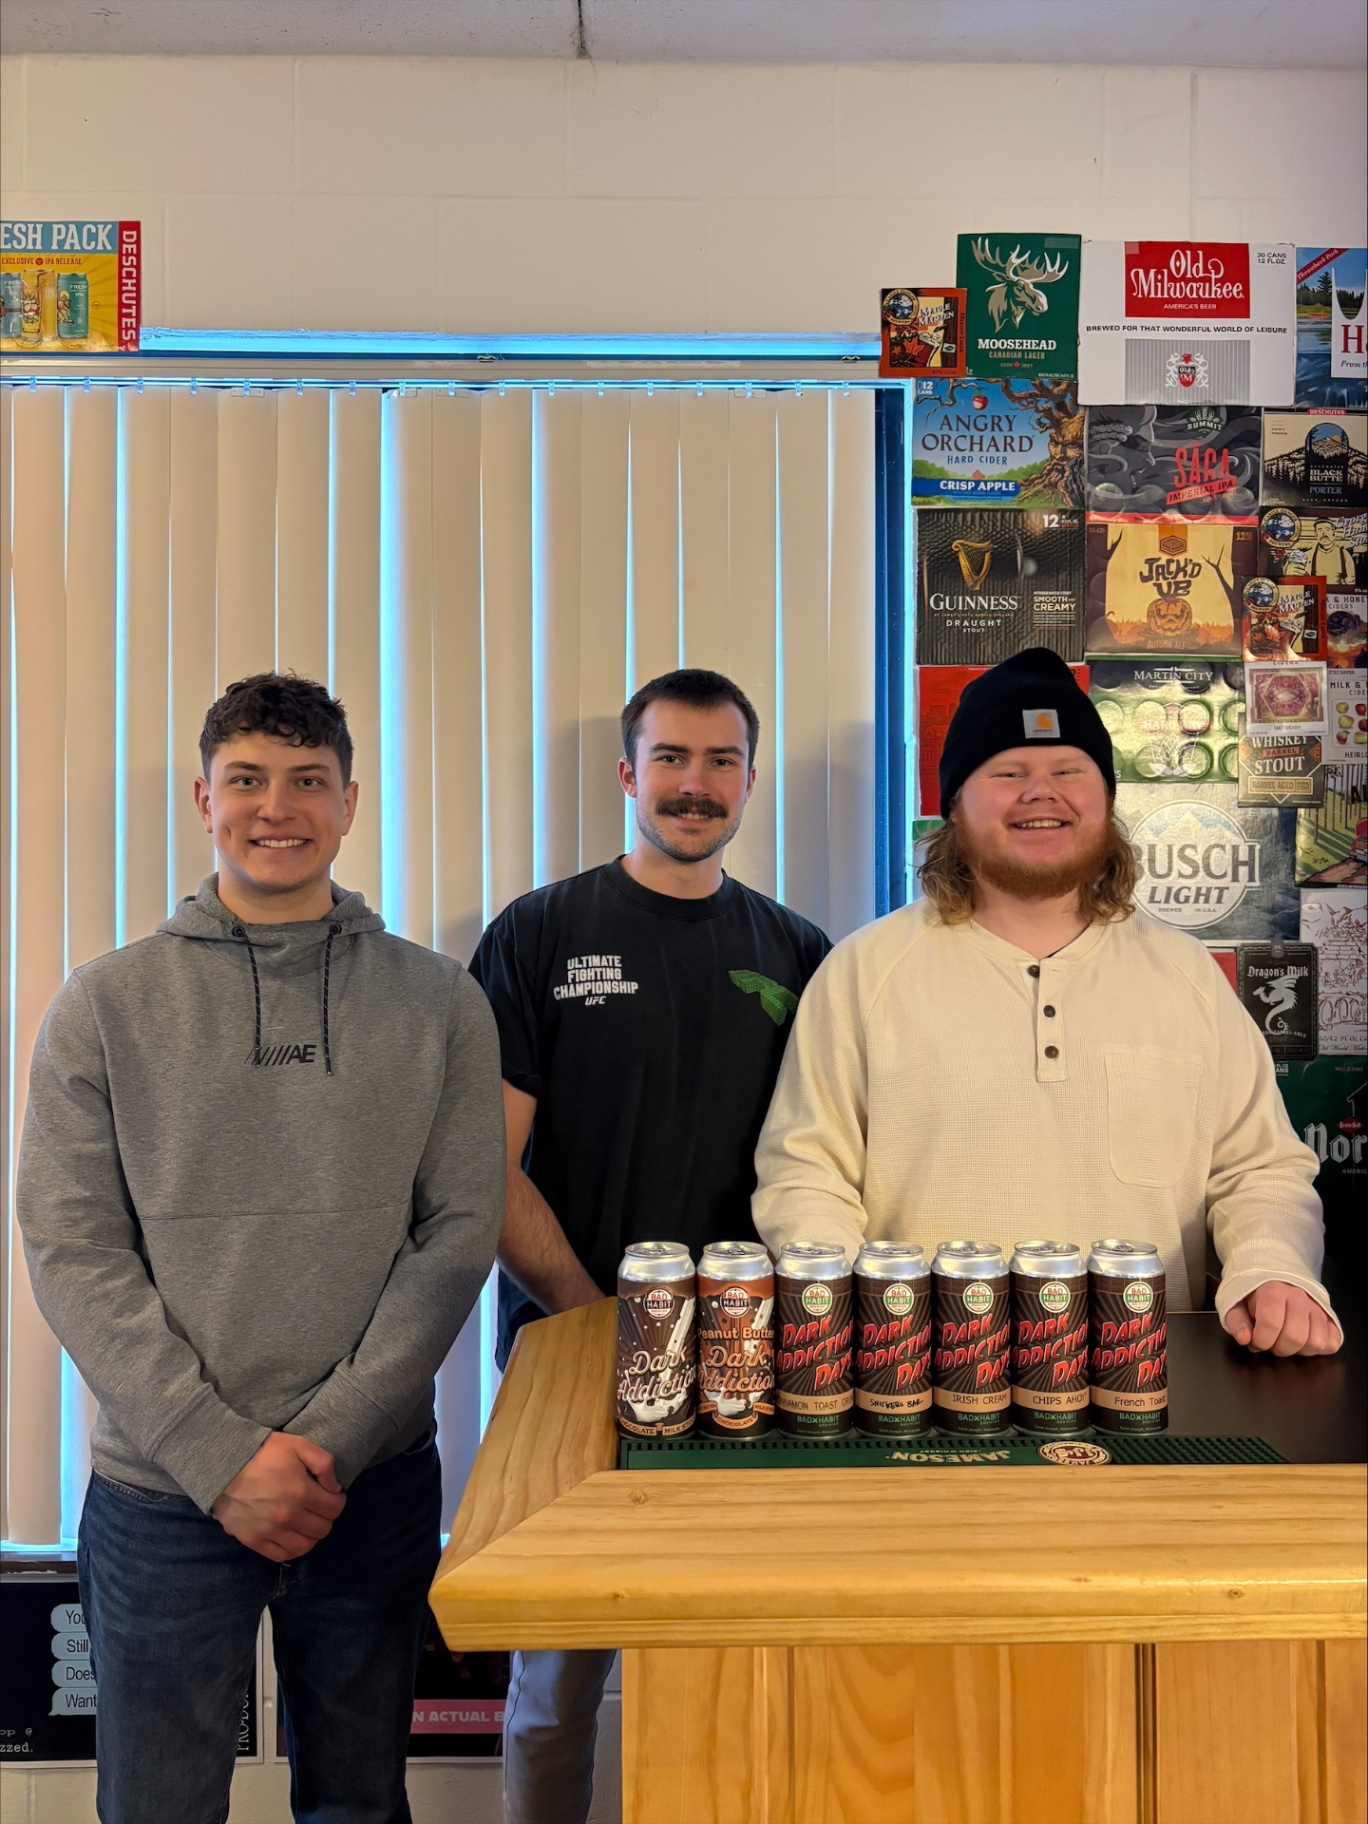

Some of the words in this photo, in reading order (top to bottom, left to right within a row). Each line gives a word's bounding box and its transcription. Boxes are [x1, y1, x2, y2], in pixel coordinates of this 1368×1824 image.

[51, 224, 113, 250] PACK
[1169, 250, 1224, 279] Old
[122, 230, 137, 341] DESCHUTES
[1130, 268, 1245, 299] Milwaukee
[1163, 325, 1212, 333] WONDERFUL
[1256, 326, 1288, 334] LEISURE
[977, 338, 1057, 351] MOOSEHEAD
[989, 351, 1022, 359] CANADIAN
[1024, 352, 1045, 360] LAGER
[1340, 360, 1361, 368] From
[921, 381, 934, 390] 12
[938, 414, 1018, 432] ANGRY
[1187, 421, 1223, 431] SUMMIT
[921, 433, 1034, 453] ORCHARD
[947, 455, 974, 465] HARD
[979, 455, 1008, 466] CIDER
[939, 480, 976, 491] CRISP
[977, 481, 1016, 491] APPLE
[1169, 485, 1215, 502] IMPERIAL
[1218, 480, 1233, 490] IPA
[1309, 486, 1342, 494] PORTER
[1043, 514, 1059, 528] 12
[1139, 557, 1202, 583] JACK'D
[1033, 603, 1077, 611] CREAMY
[946, 619, 1002, 627] DRAUGHT
[1147, 640, 1172, 649] AUTUMN
[1173, 641, 1186, 650] ALE
[1134, 670, 1182, 681] MARTIN
[1185, 671, 1214, 681] CITY
[1330, 681, 1351, 689] MILK
[1251, 735, 1309, 749] WHISKEY
[1266, 748, 1297, 756] BARREL
[1254, 756, 1306, 775] STOUT
[1147, 886, 1230, 905] LIGHT
[566, 954, 622, 971] ULTIMATE
[567, 968, 622, 983] FIGHTING
[1247, 965, 1284, 979] Dragon's
[1286, 965, 1309, 977] Milk
[553, 981, 639, 1001] CHAMPIONSHIP
[585, 996, 607, 1006] UFC
[727, 1291, 745, 1300] BAD
[809, 1289, 826, 1297] BAD
[891, 1289, 908, 1297] BAD
[970, 1288, 987, 1296] BAD
[1047, 1287, 1064, 1295] BAD
[1131, 1287, 1147, 1295] BAD
[651, 1293, 668, 1301] BAD
[806, 1296, 830, 1304] HABIT
[887, 1296, 911, 1304] HABIT
[967, 1295, 991, 1303] HABIT
[1043, 1294, 1067, 1302] HABIT
[1127, 1294, 1151, 1302] HABIT
[646, 1300, 672, 1308] HABIT
[723, 1299, 748, 1307] HABIT
[783, 1314, 833, 1348] DARK
[863, 1314, 914, 1348] DARK
[942, 1312, 994, 1347] DARK
[1018, 1311, 1071, 1345] DARK
[1101, 1311, 1153, 1346] DARK
[856, 1319, 932, 1373] ADDICTIO
[935, 1317, 1010, 1371] ADDICTIO
[1012, 1317, 1088, 1369] ADDICTIO
[629, 1341, 688, 1375] Dark
[705, 1344, 766, 1368] Dark
[906, 1398, 924, 1409] BAR
[952, 1393, 979, 1405] IRISH
[982, 1393, 1007, 1405] CREAM
[1032, 1395, 1062, 1406] CHIPS
[1114, 1396, 1146, 1407] French
[813, 1400, 838, 1411] TOAST
[716, 1417, 755, 1427] CHOCOLATE
[664, 1425, 681, 1435] MILK
[890, 1450, 1011, 1463] JAMESON
[66, 1639, 89, 1653] Still
[65, 1693, 97, 1708] Want
[428, 1710, 490, 1723] ACTUAL
